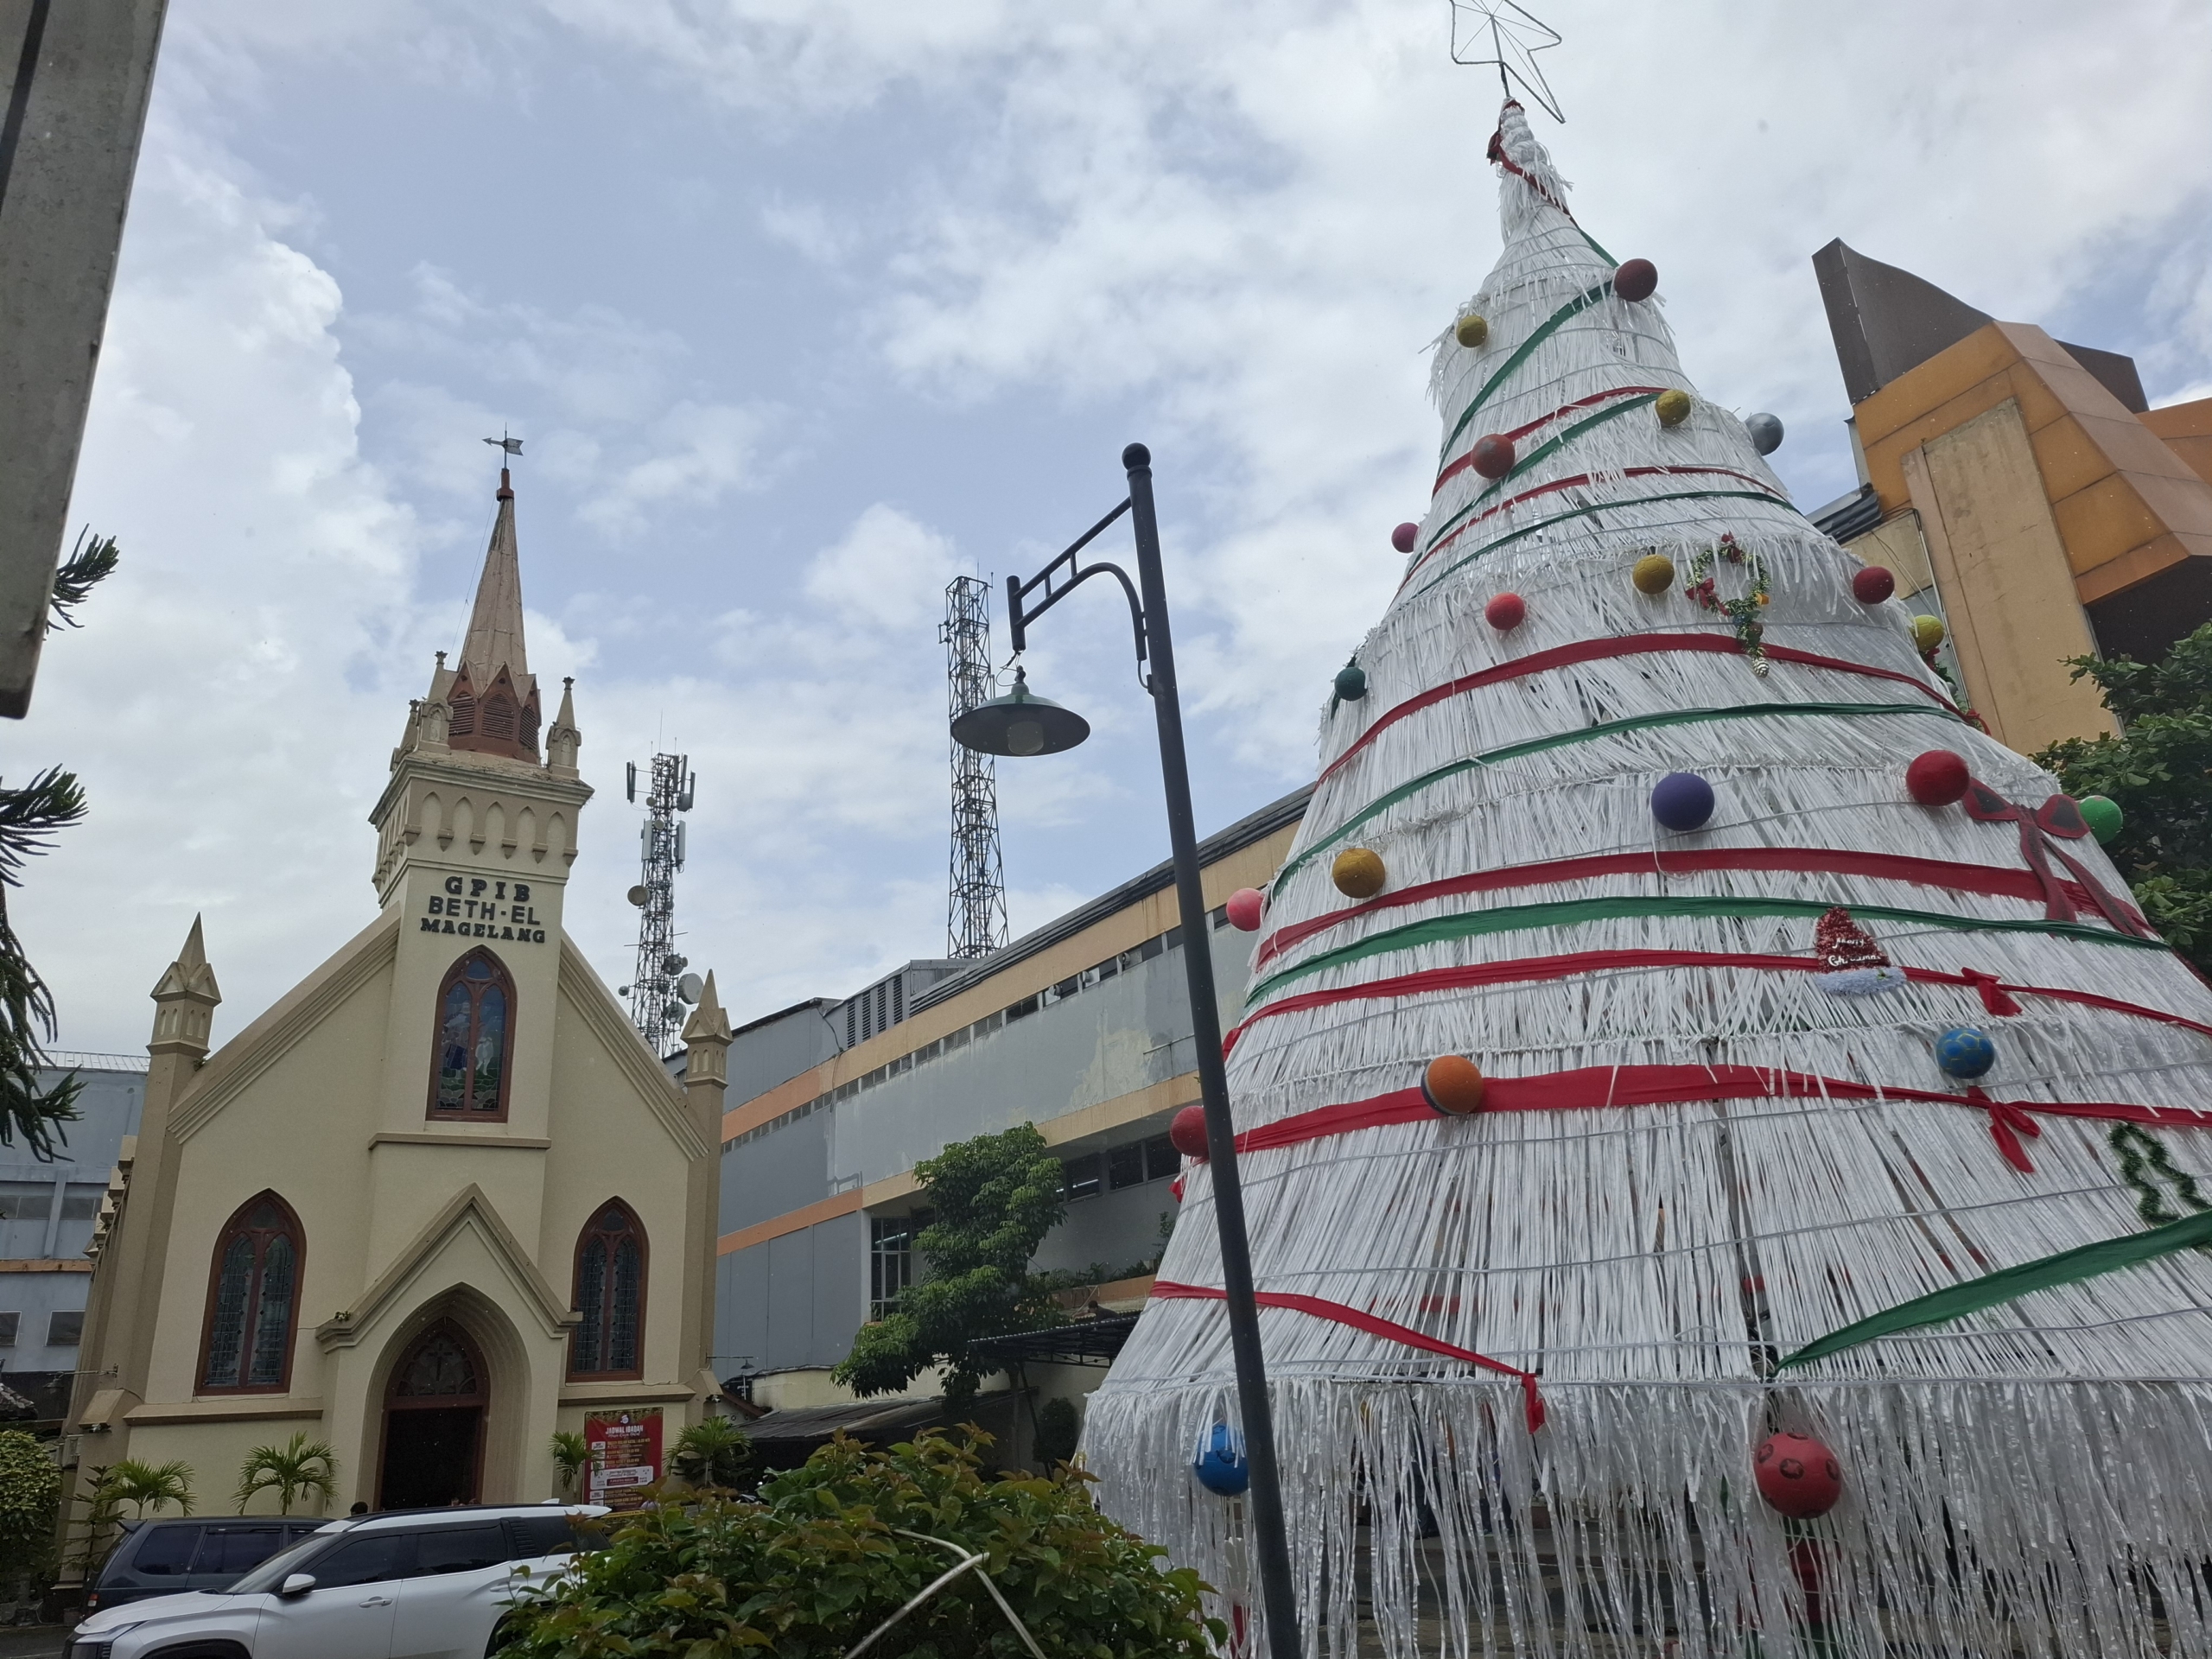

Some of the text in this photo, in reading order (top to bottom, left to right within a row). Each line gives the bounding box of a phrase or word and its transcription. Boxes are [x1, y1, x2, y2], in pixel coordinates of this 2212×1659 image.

[445, 875, 531, 902] GPIB
[420, 918, 545, 944] MAGELANG
[626, 1425, 644, 1433] IBADAH
